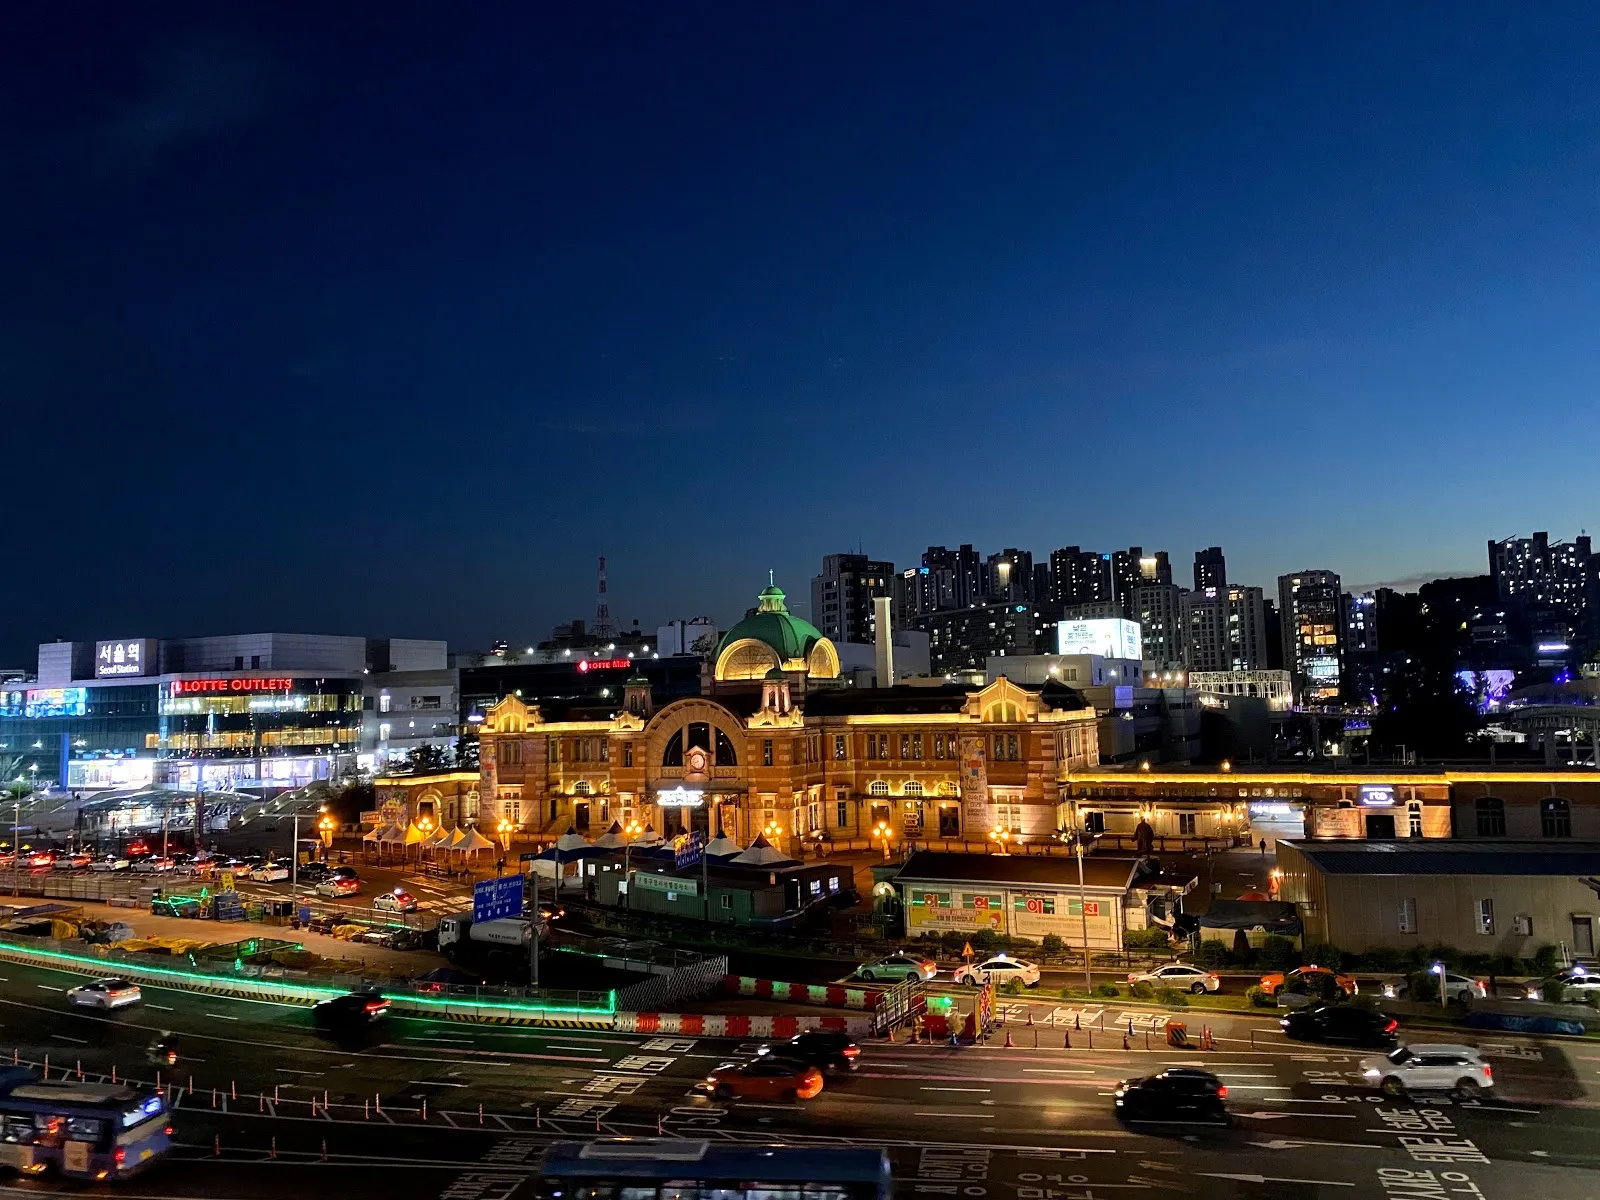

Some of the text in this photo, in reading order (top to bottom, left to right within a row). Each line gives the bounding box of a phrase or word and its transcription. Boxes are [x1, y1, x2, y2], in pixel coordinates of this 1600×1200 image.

[99, 643, 140, 664] 서울역
[99, 664, 140, 675] Seoul Station
[588, 659, 631, 669] LOTTE Mart
[184, 678, 292, 692] LOTTE OUTLETS
[1026, 898, 1043, 914] 이
